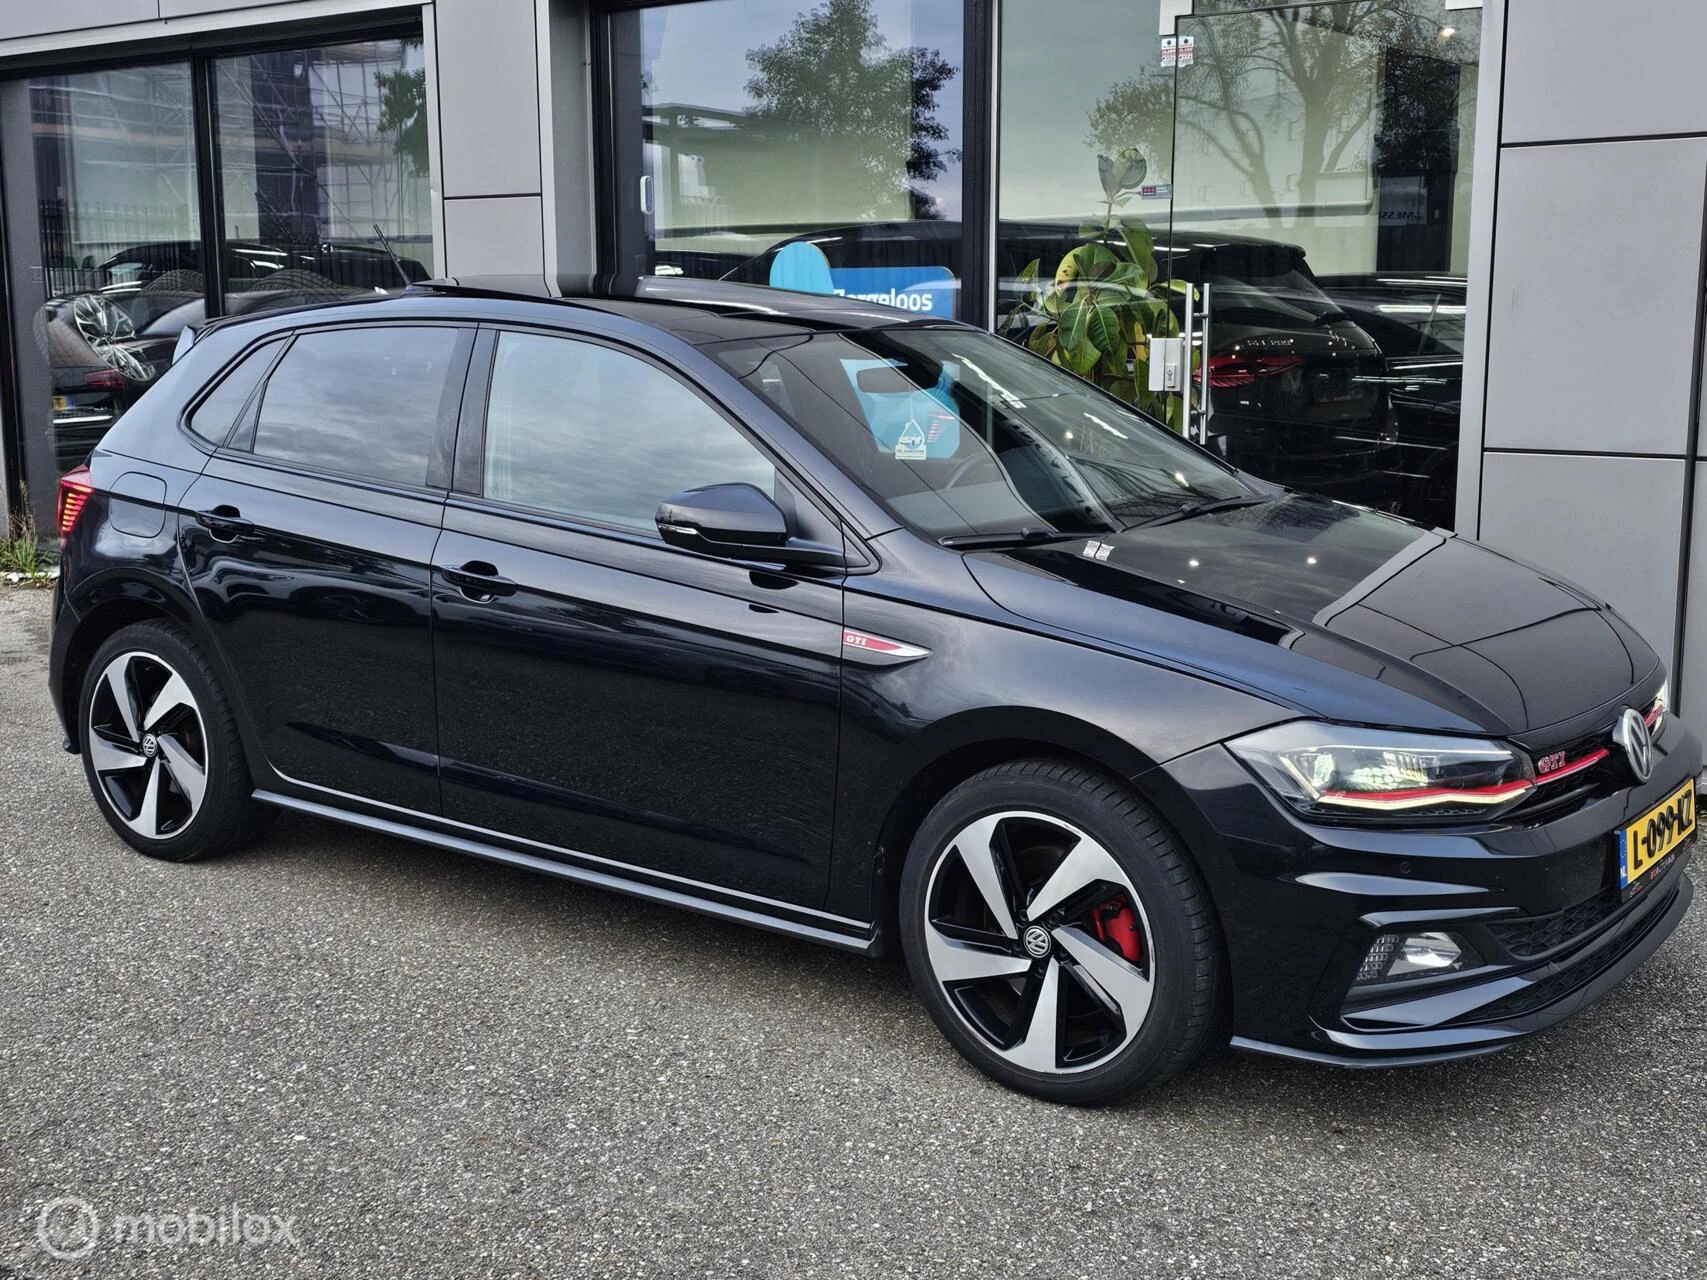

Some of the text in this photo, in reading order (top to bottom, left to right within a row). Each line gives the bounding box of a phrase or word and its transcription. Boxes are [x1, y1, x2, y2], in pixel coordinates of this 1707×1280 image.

[833, 288, 933, 311] eloos
[846, 634, 868, 646] GTI
[1538, 751, 1567, 774] GTI
